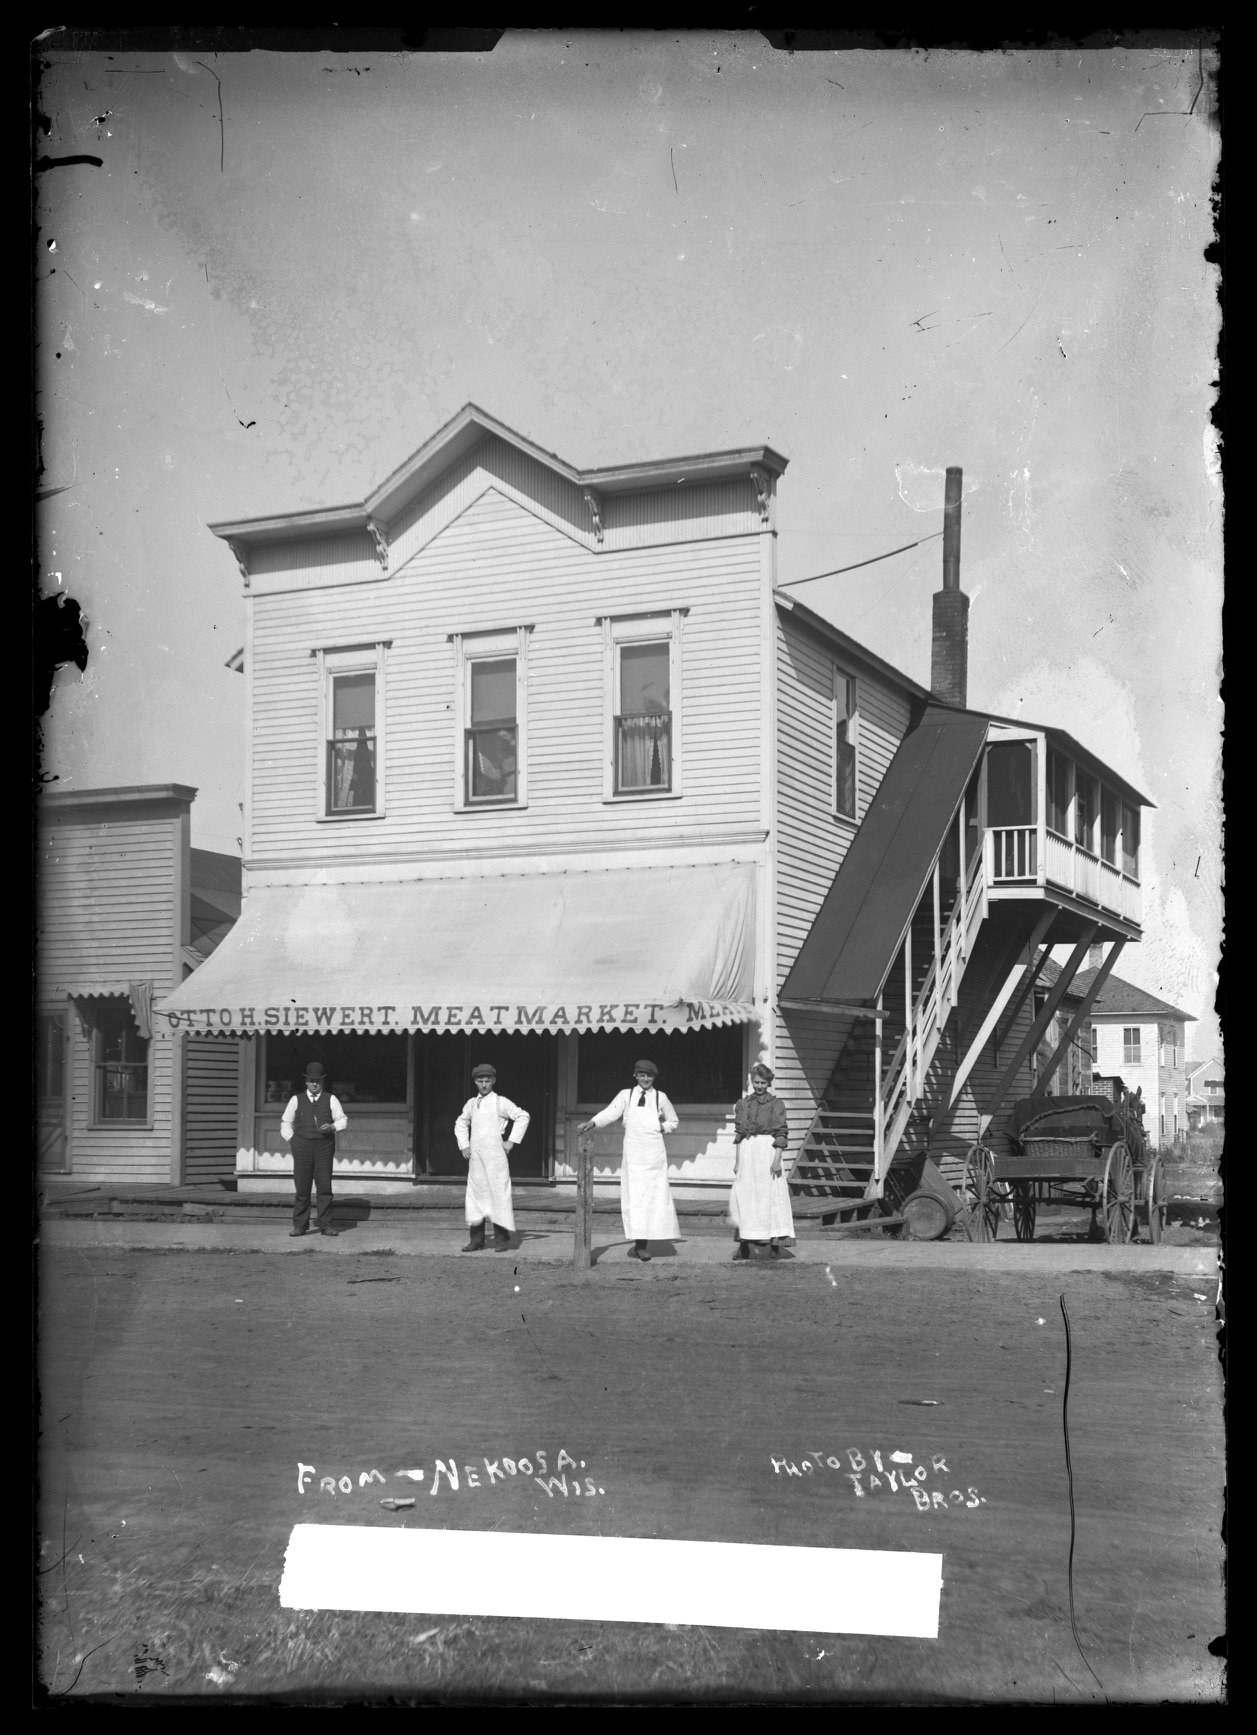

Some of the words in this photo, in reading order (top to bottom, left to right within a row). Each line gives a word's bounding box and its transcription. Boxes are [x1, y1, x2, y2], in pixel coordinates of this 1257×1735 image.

[168, 1008, 232, 1028] OTTO
[239, 1007, 262, 1026] H.
[264, 1005, 399, 1026] SIEWERT.
[410, 1005, 510, 1026] MEAT
[514, 1003, 667, 1026] MARKET.
